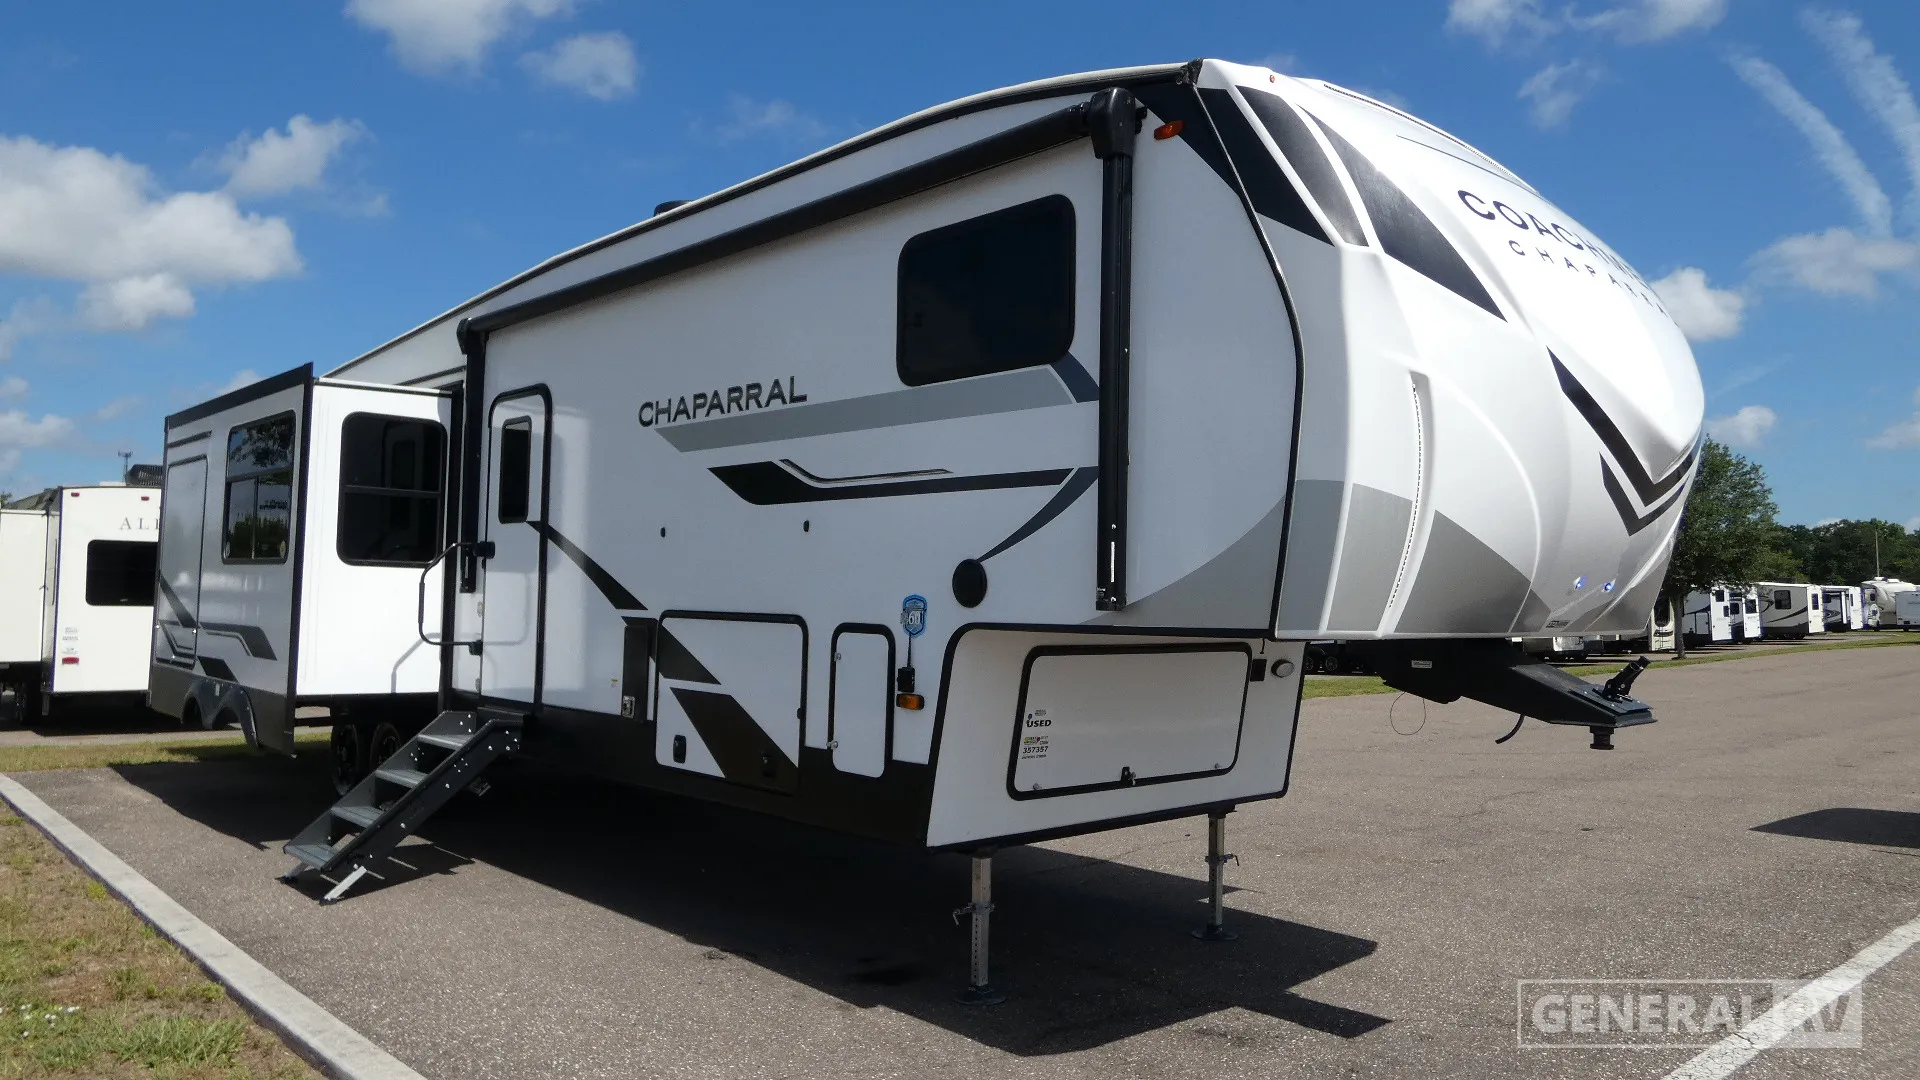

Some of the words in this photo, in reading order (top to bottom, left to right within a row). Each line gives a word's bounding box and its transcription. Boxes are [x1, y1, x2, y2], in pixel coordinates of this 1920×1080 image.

[1508, 240, 1680, 328] CHAPARRA
[638, 376, 807, 427] CHAPARRAL
[1026, 719, 1052, 728] USED
[1023, 745, 1049, 754] 357357
